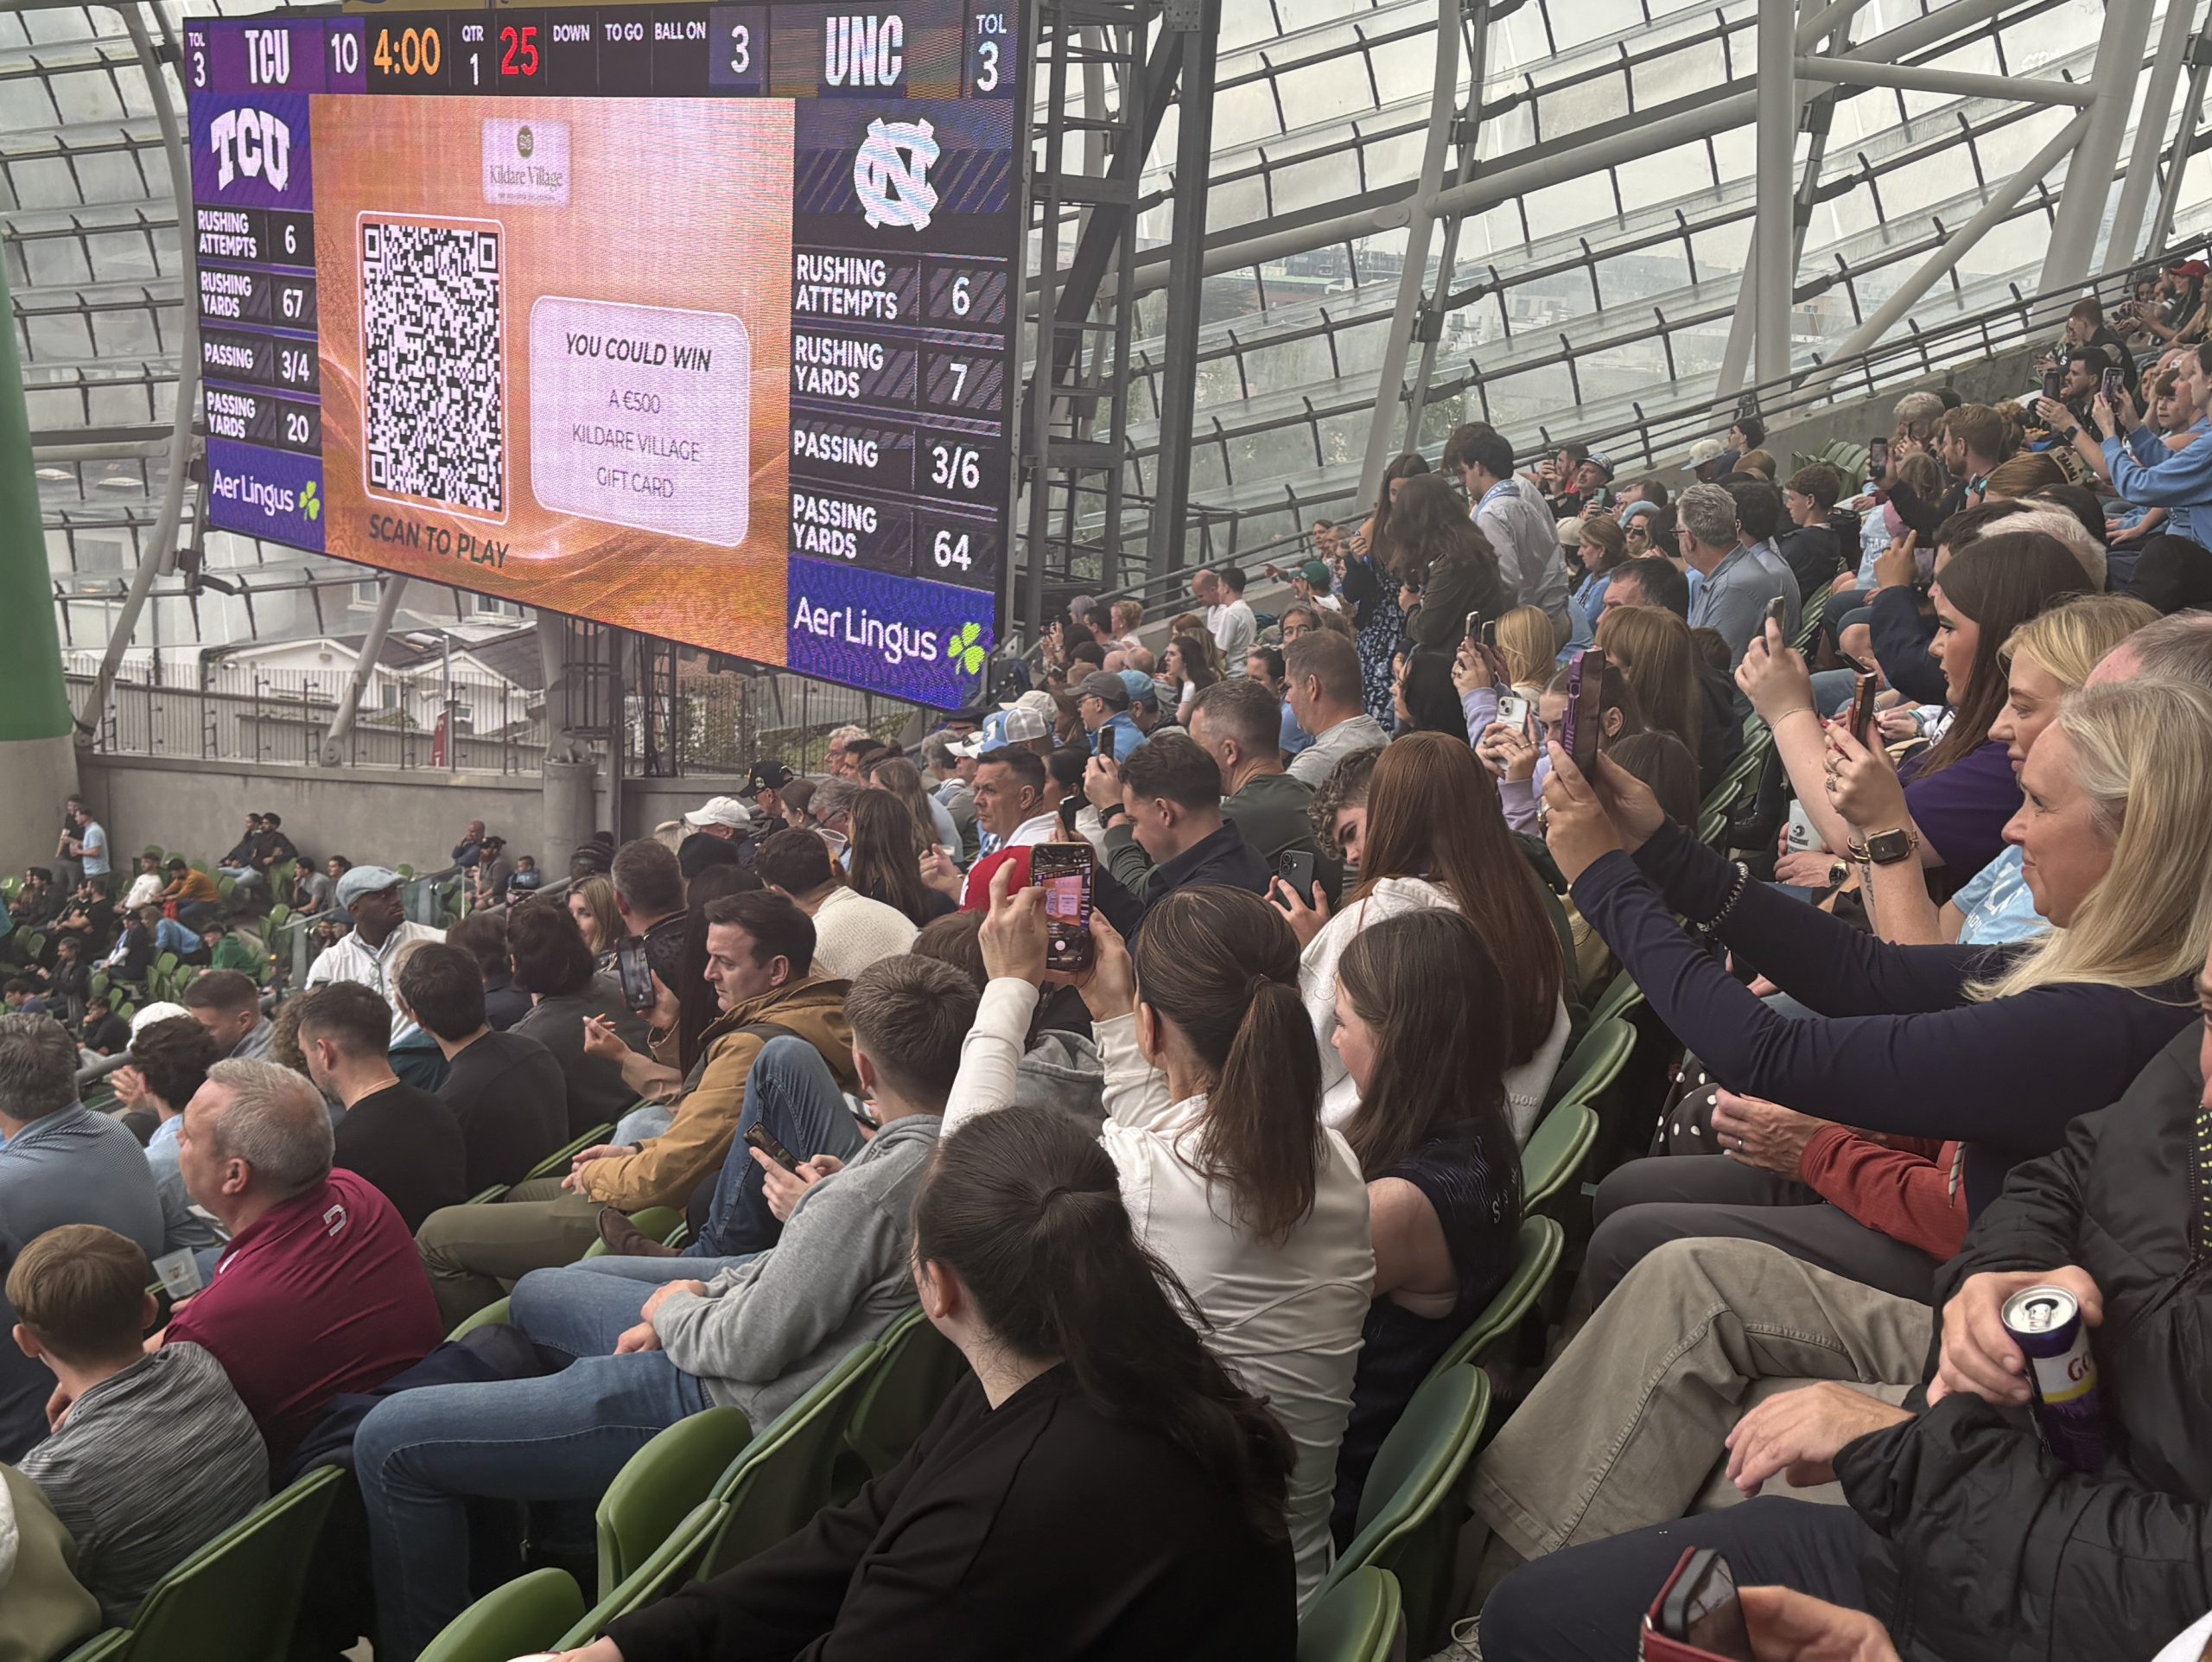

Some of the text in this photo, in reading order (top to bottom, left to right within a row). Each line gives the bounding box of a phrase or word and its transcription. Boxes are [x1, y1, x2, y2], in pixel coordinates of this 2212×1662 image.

[188, 32, 206, 48] TOL
[461, 24, 484, 43] QTR
[553, 24, 590, 42] DOWN
[605, 23, 644, 41] TO GO
[654, 22, 706, 41] BALL ON
[976, 13, 1007, 35] TOL
[245, 29, 289, 85] TCU
[330, 33, 359, 74] 10
[373, 27, 442, 75] 4:00
[499, 26, 539, 76] 25
[730, 25, 750, 73] 3
[825, 15, 904, 86] UNC
[976, 41, 998, 92] 3
[194, 52, 206, 87] 3
[469, 53, 480, 86] 1
[210, 107, 290, 193] TCU
[489, 164, 563, 192] Kildare Village
[197, 210, 250, 234] RUSHING
[284, 225, 296, 254] 6
[199, 233, 257, 258] ATTEMPTS
[200, 271, 252, 297] RUSHING
[796, 253, 887, 288] RUSHING
[201, 294, 240, 318] YARDS
[283, 288, 303, 318] 67
[796, 284, 899, 321] ATTEMPTS
[951, 277, 971, 316] 6
[204, 342, 254, 369] PASSING
[282, 350, 310, 383] 3/4
[566, 332, 712, 373] YOU COULD WIN
[795, 334, 885, 372] RUSHING
[795, 365, 861, 399] YARDS
[950, 362, 969, 402] 7
[207, 391, 256, 419] PASSING
[609, 389, 661, 414] A €500
[207, 413, 245, 439] YARDS
[287, 412, 309, 443] 20
[573, 423, 701, 462] KILDARE VILLAGE
[794, 430, 879, 469] PASSING
[597, 467, 674, 499] GIFT CARD
[931, 445, 980, 490] 3/6
[213, 468, 294, 517] Aer Lingus
[793, 493, 878, 534] PASSING
[368, 513, 510, 570] SCAN TO PLAY
[793, 522, 858, 560] YARDS
[933, 532, 972, 571] 64
[793, 595, 938, 665] Aer Lingus
